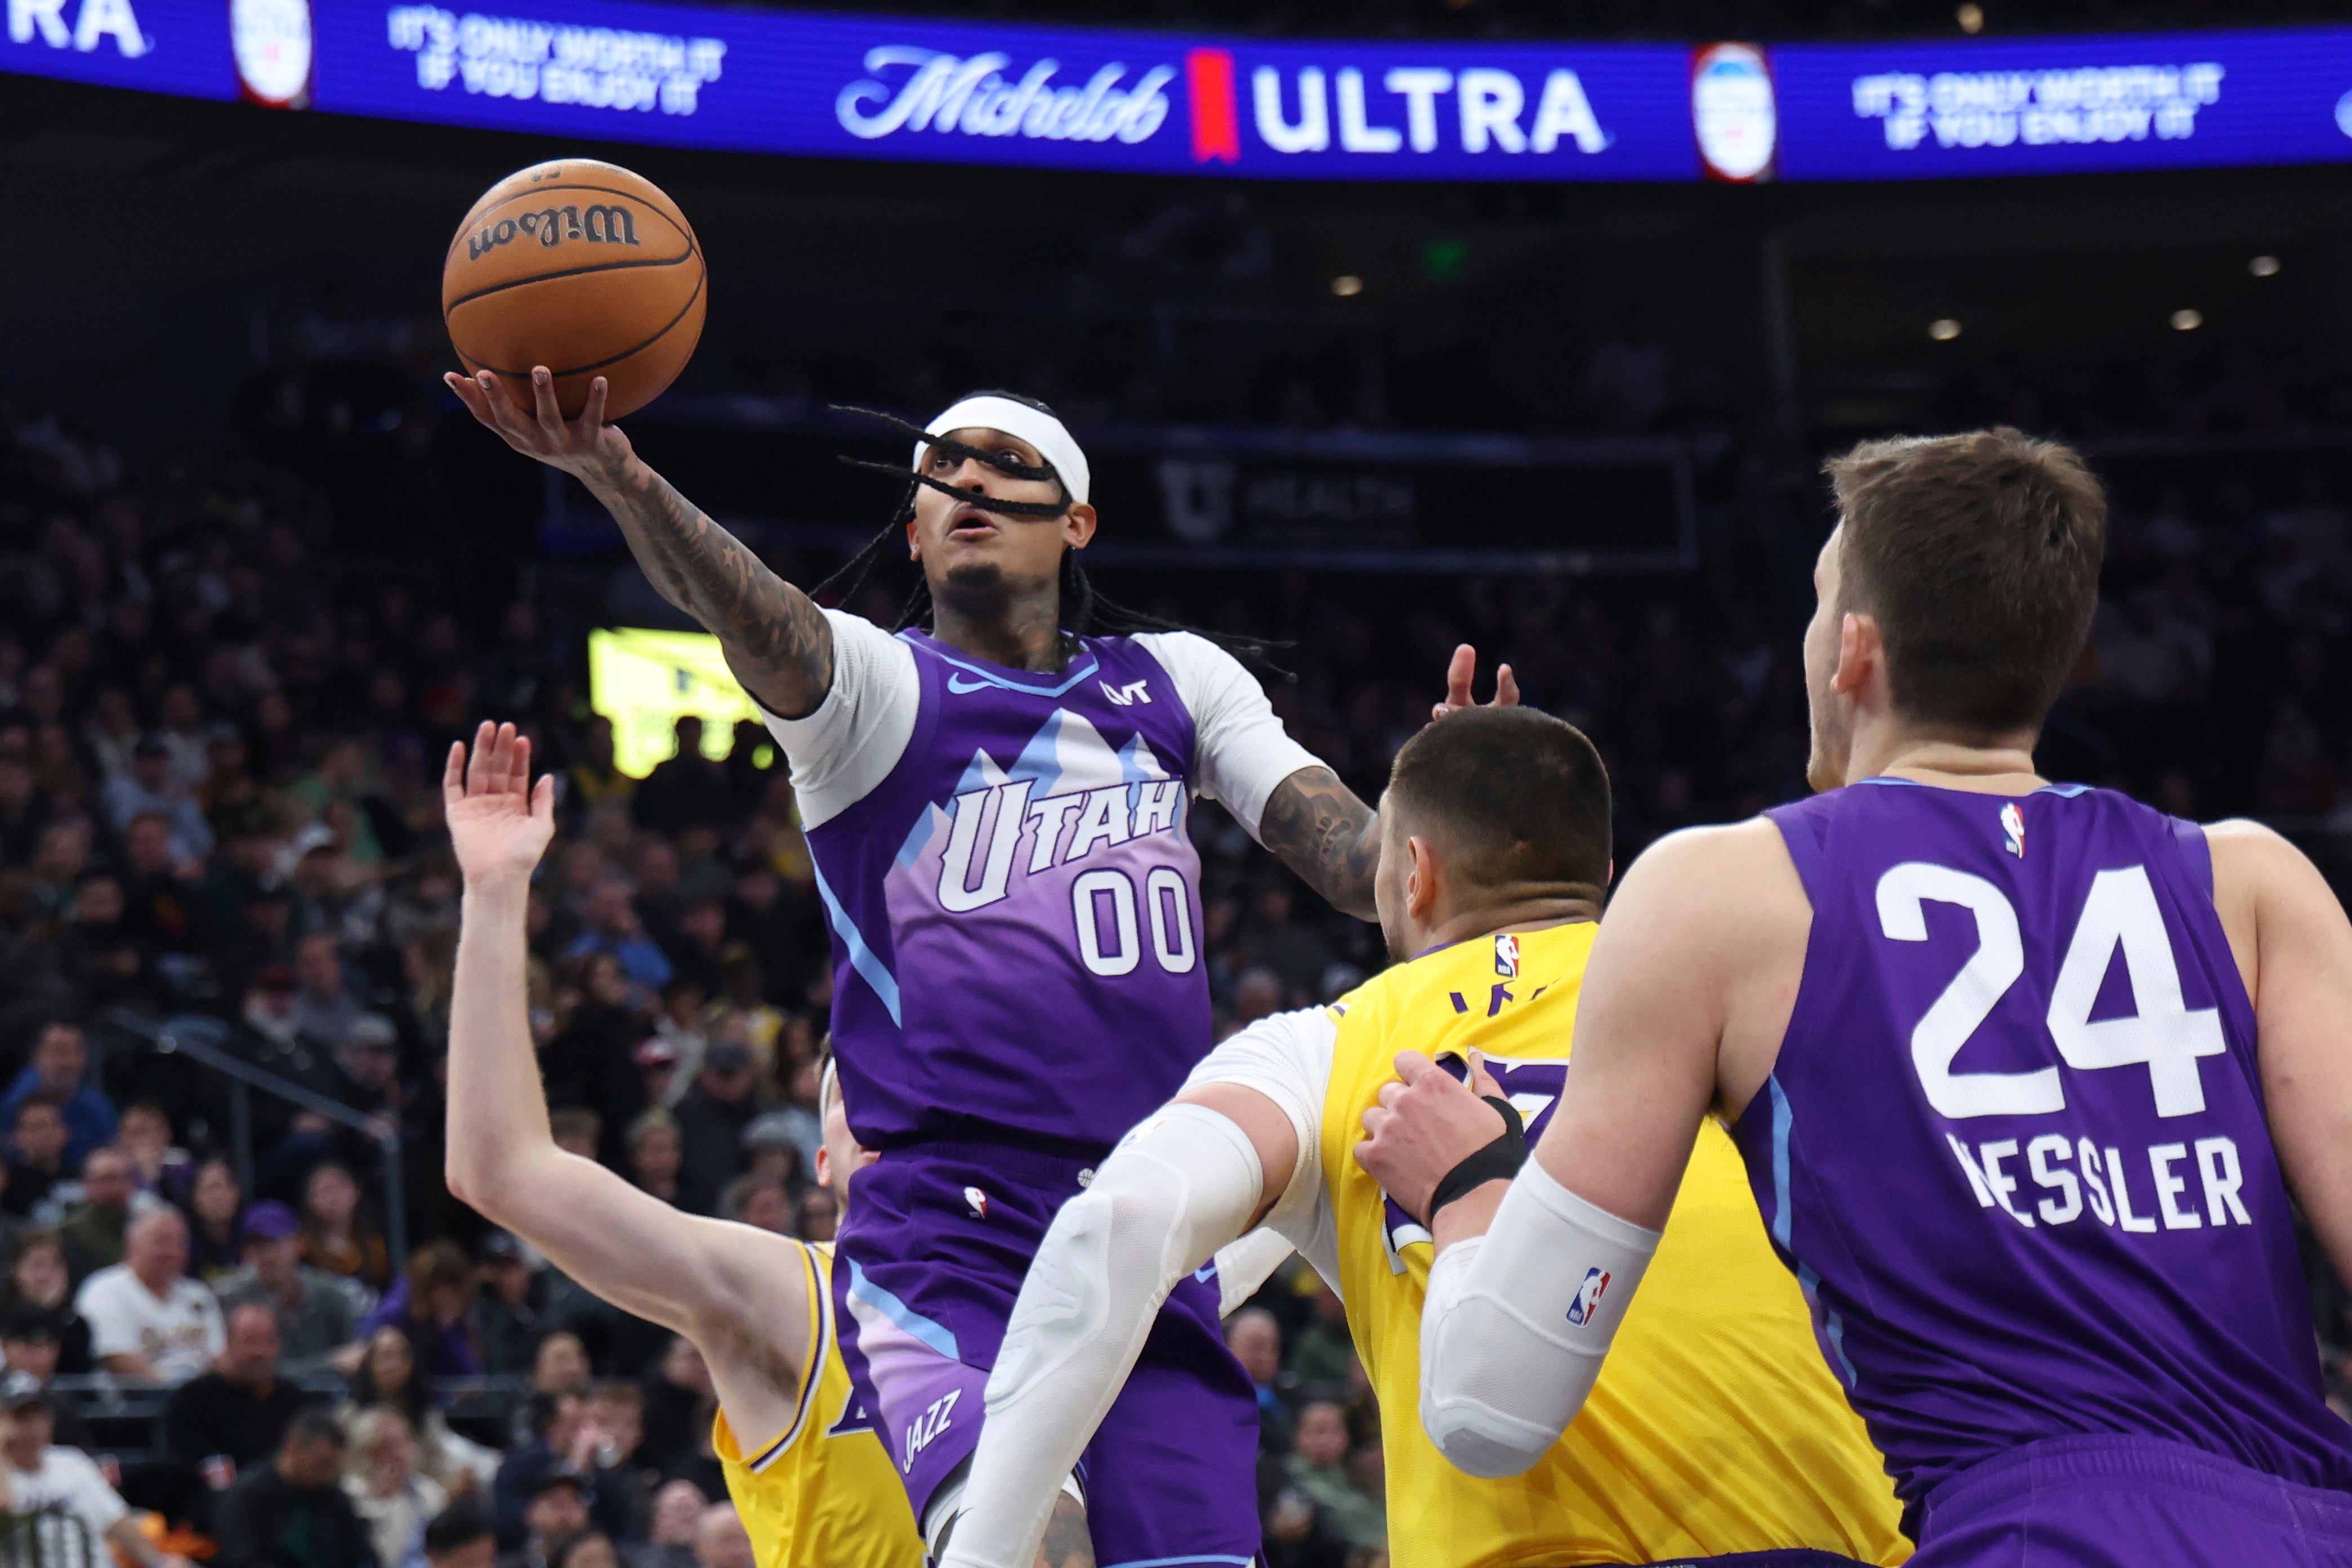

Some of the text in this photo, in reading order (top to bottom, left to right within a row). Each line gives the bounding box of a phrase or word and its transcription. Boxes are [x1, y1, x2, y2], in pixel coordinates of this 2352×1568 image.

[836, 45, 1605, 154] Michelob ULTRA
[468, 204, 641, 261] Wilson
[938, 778, 1182, 913] UTAH
[1072, 865, 1196, 976] 00
[1498, 964, 1511, 976] NBA
[1876, 861, 2227, 1119] 24
[1569, 1308, 1583, 1323] NBA
[903, 1388, 962, 1475] JAZZ
